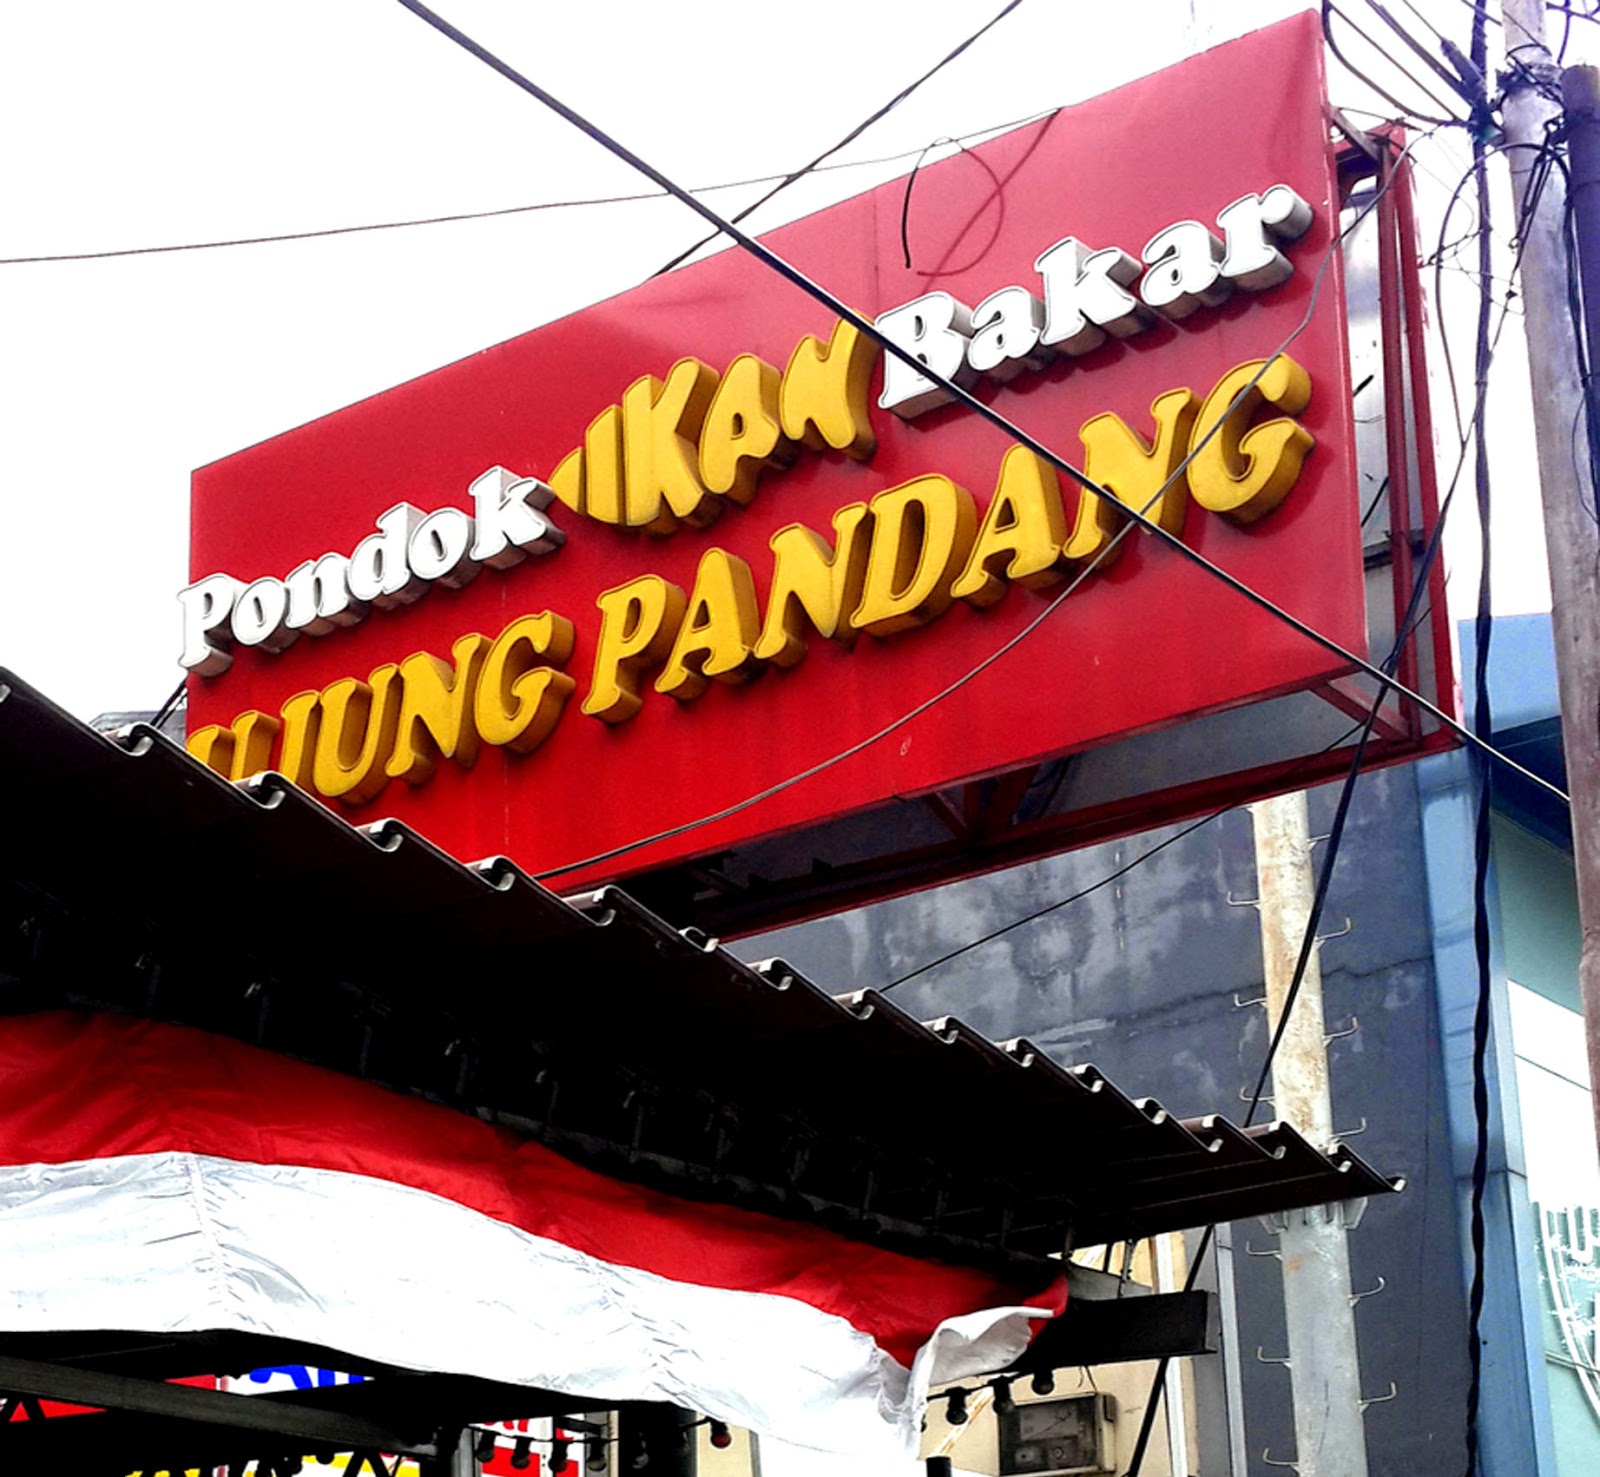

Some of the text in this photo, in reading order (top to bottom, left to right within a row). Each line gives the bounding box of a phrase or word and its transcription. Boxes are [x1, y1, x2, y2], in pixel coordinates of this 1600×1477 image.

[177, 183, 1310, 676] Pondok IKAN Bakar
[581, 352, 1313, 718] PANDANG
